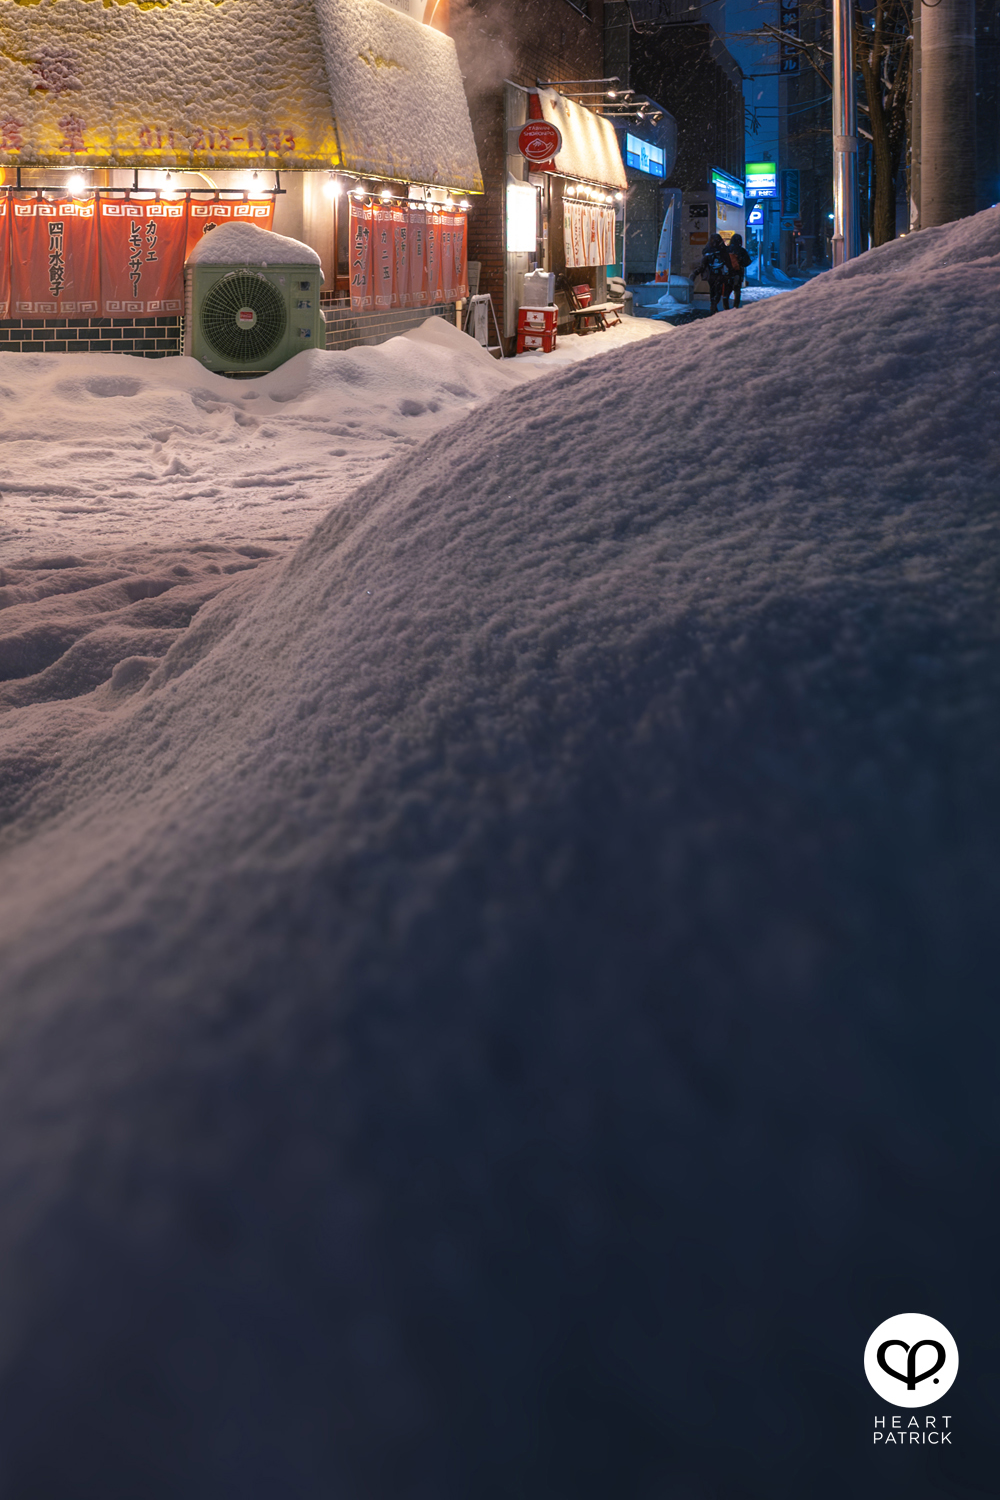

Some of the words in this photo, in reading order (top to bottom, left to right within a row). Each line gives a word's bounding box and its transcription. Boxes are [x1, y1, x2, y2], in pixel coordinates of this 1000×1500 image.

[144, 220, 159, 263] カツエ
[749, 211, 762, 224] P
[48, 221, 65, 298] 四川水餃子
[128, 220, 143, 298] レモンサワー
